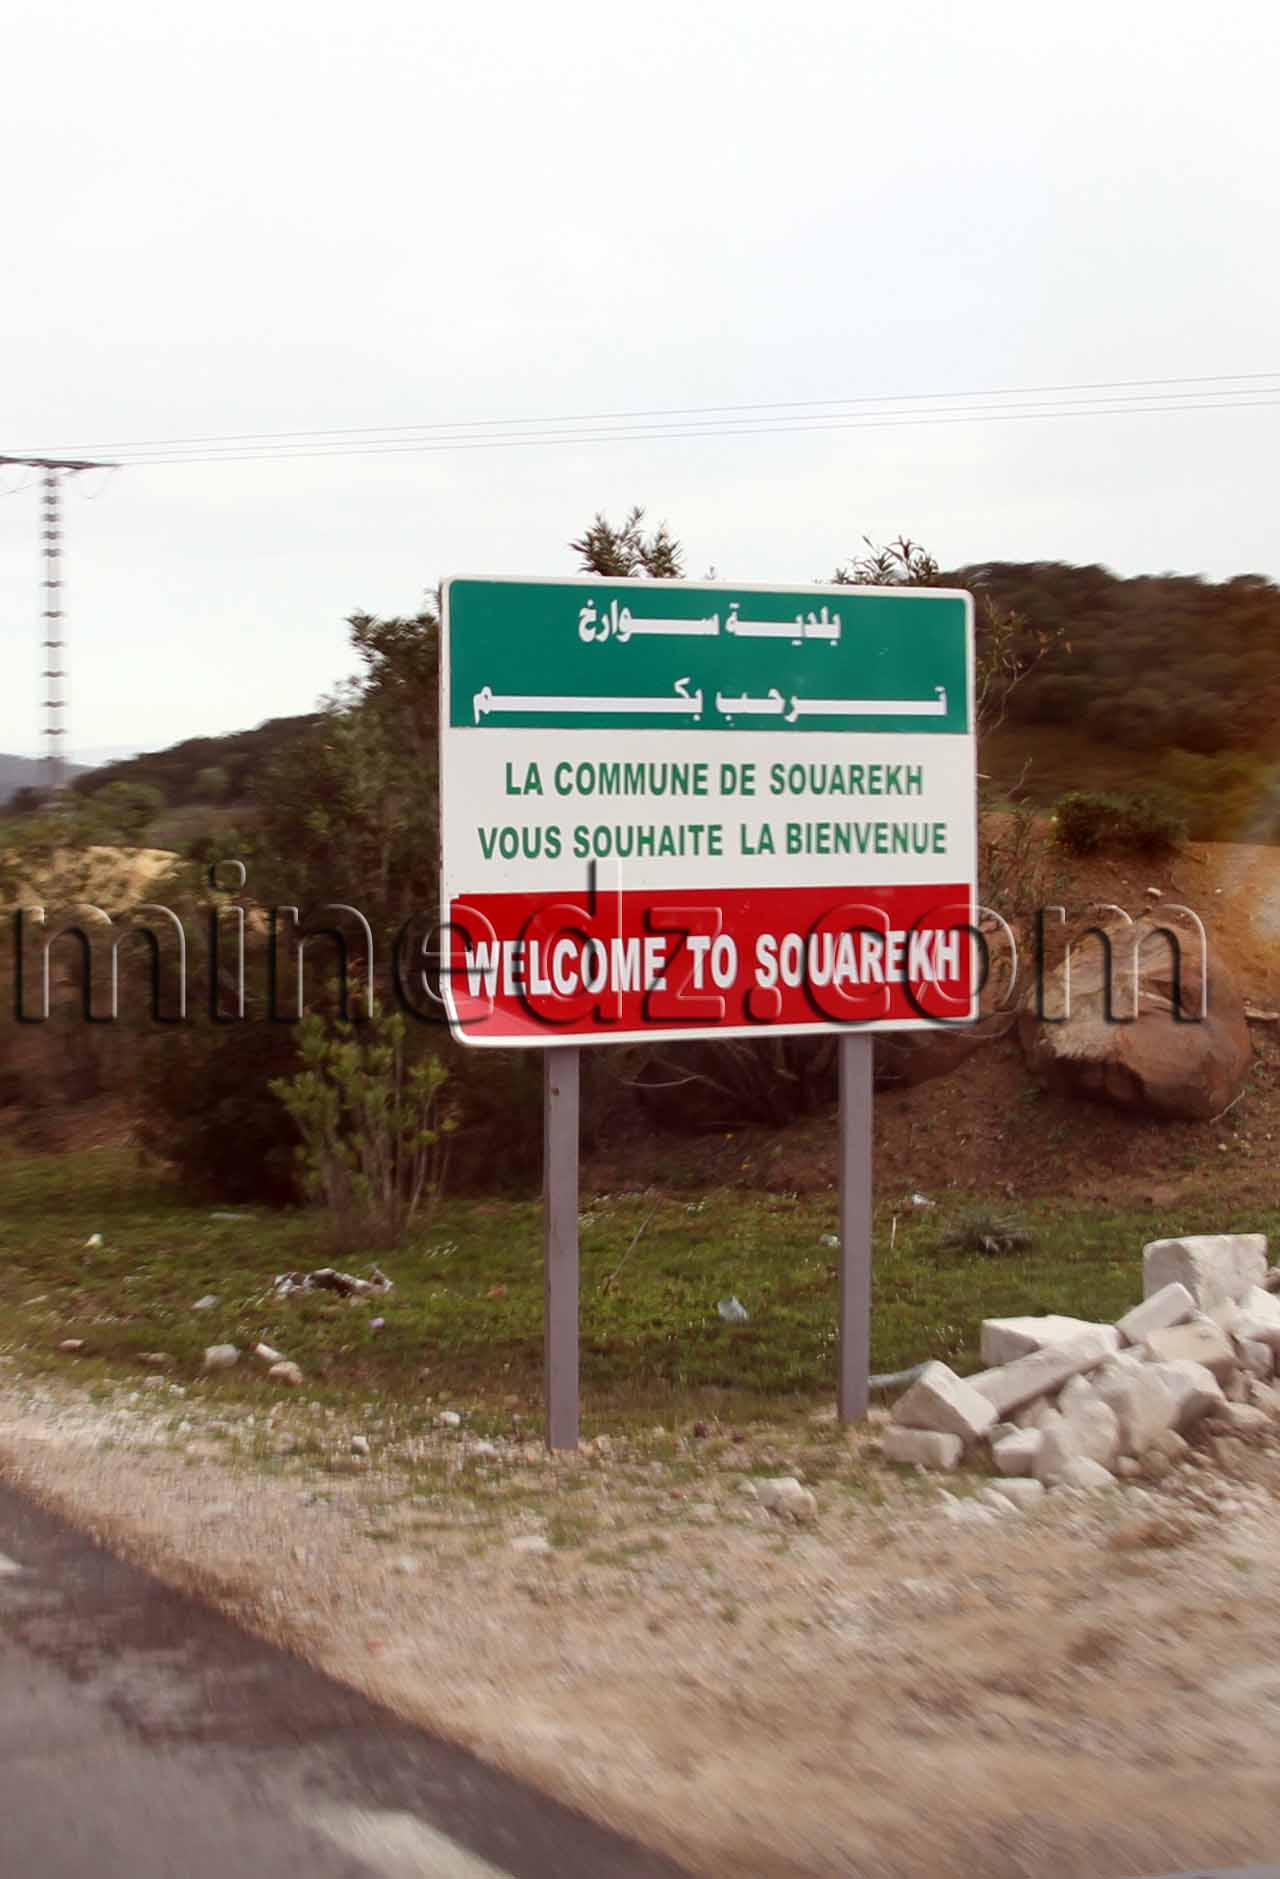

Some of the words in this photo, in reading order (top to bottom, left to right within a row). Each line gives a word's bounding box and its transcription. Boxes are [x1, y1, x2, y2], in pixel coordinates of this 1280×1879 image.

[505, 762, 544, 797] LA
[553, 761, 710, 797] COMMUNE
[721, 763, 756, 796] DE
[768, 762, 924, 797] SOUAREKH
[477, 824, 562, 861] VOUS
[572, 823, 723, 860] SOUHAITE
[739, 823, 776, 856] LA
[785, 821, 948, 855] BIENVENUE
[464, 934, 667, 998] WELCOME
[685, 932, 738, 991] TO
[753, 927, 961, 989] SOUAREKH
